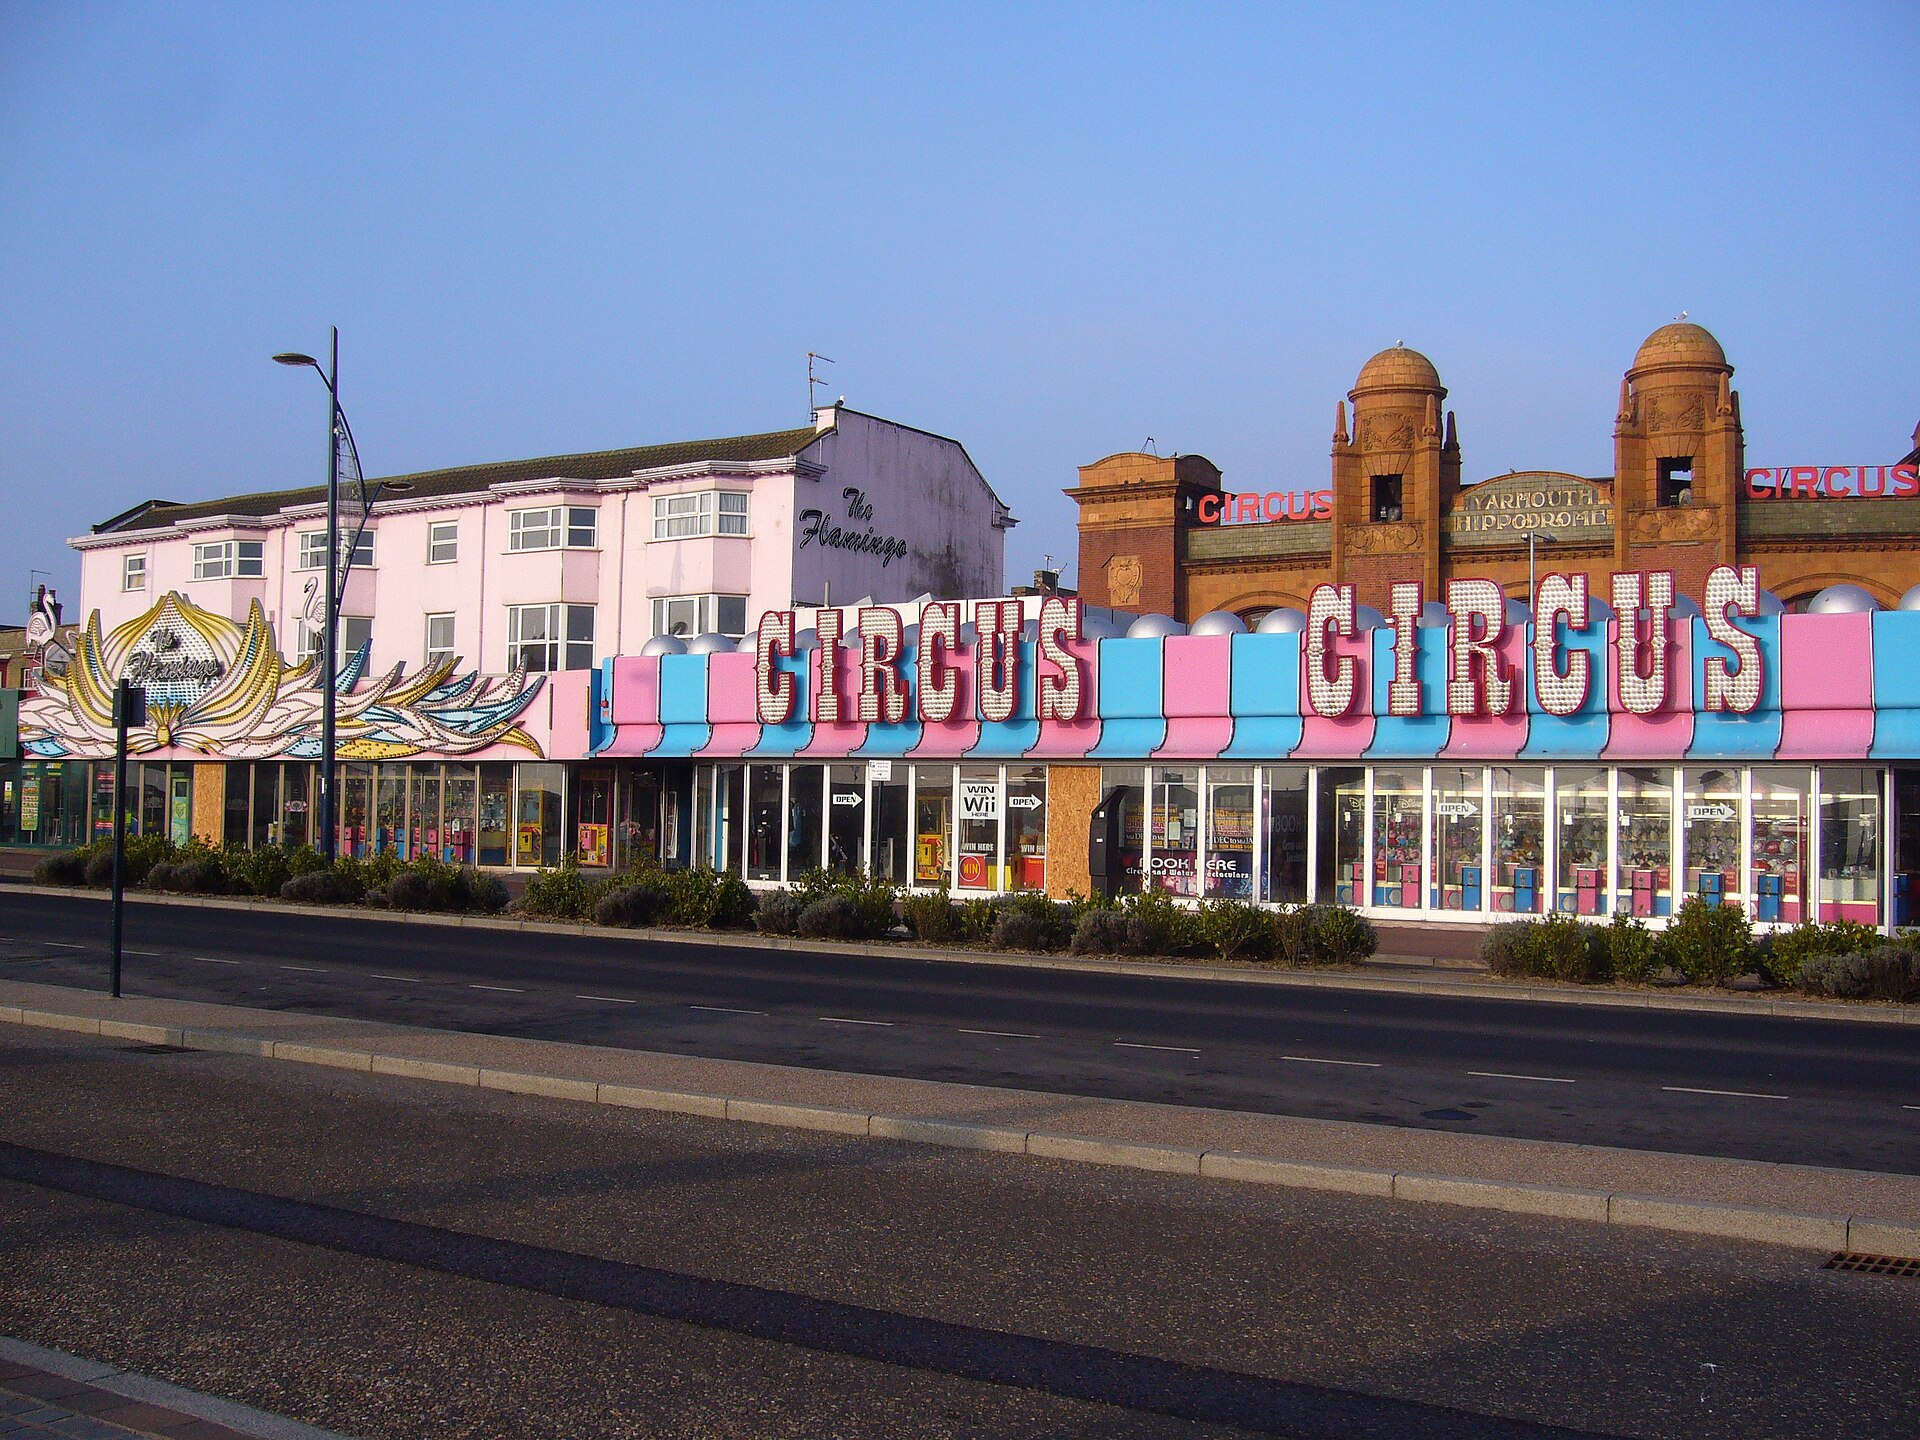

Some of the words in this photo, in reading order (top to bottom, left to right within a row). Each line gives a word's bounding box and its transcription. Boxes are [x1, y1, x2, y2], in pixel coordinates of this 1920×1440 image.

[1745, 463, 1920, 499] CIRCUS
[843, 487, 873, 520] The
[1198, 489, 1333, 523] CIRCUS
[1474, 489, 1595, 510] YARMOUTH
[1456, 510, 1607, 532] HIPPODROME
[799, 509, 907, 568] Flamingo
[1303, 563, 1765, 718] CIRCUS
[126, 651, 218, 688] Flamingo
[753, 596, 1083, 725] CIRCUS
[964, 797, 995, 812] Wii
[1012, 798, 1036, 806] OPEN
[1441, 804, 1469, 812] OPEN
[1693, 807, 1726, 816] OPEN
[962, 842, 977, 851] WIN
[978, 843, 994, 851] HERE
[1020, 844, 1035, 853] WIN
